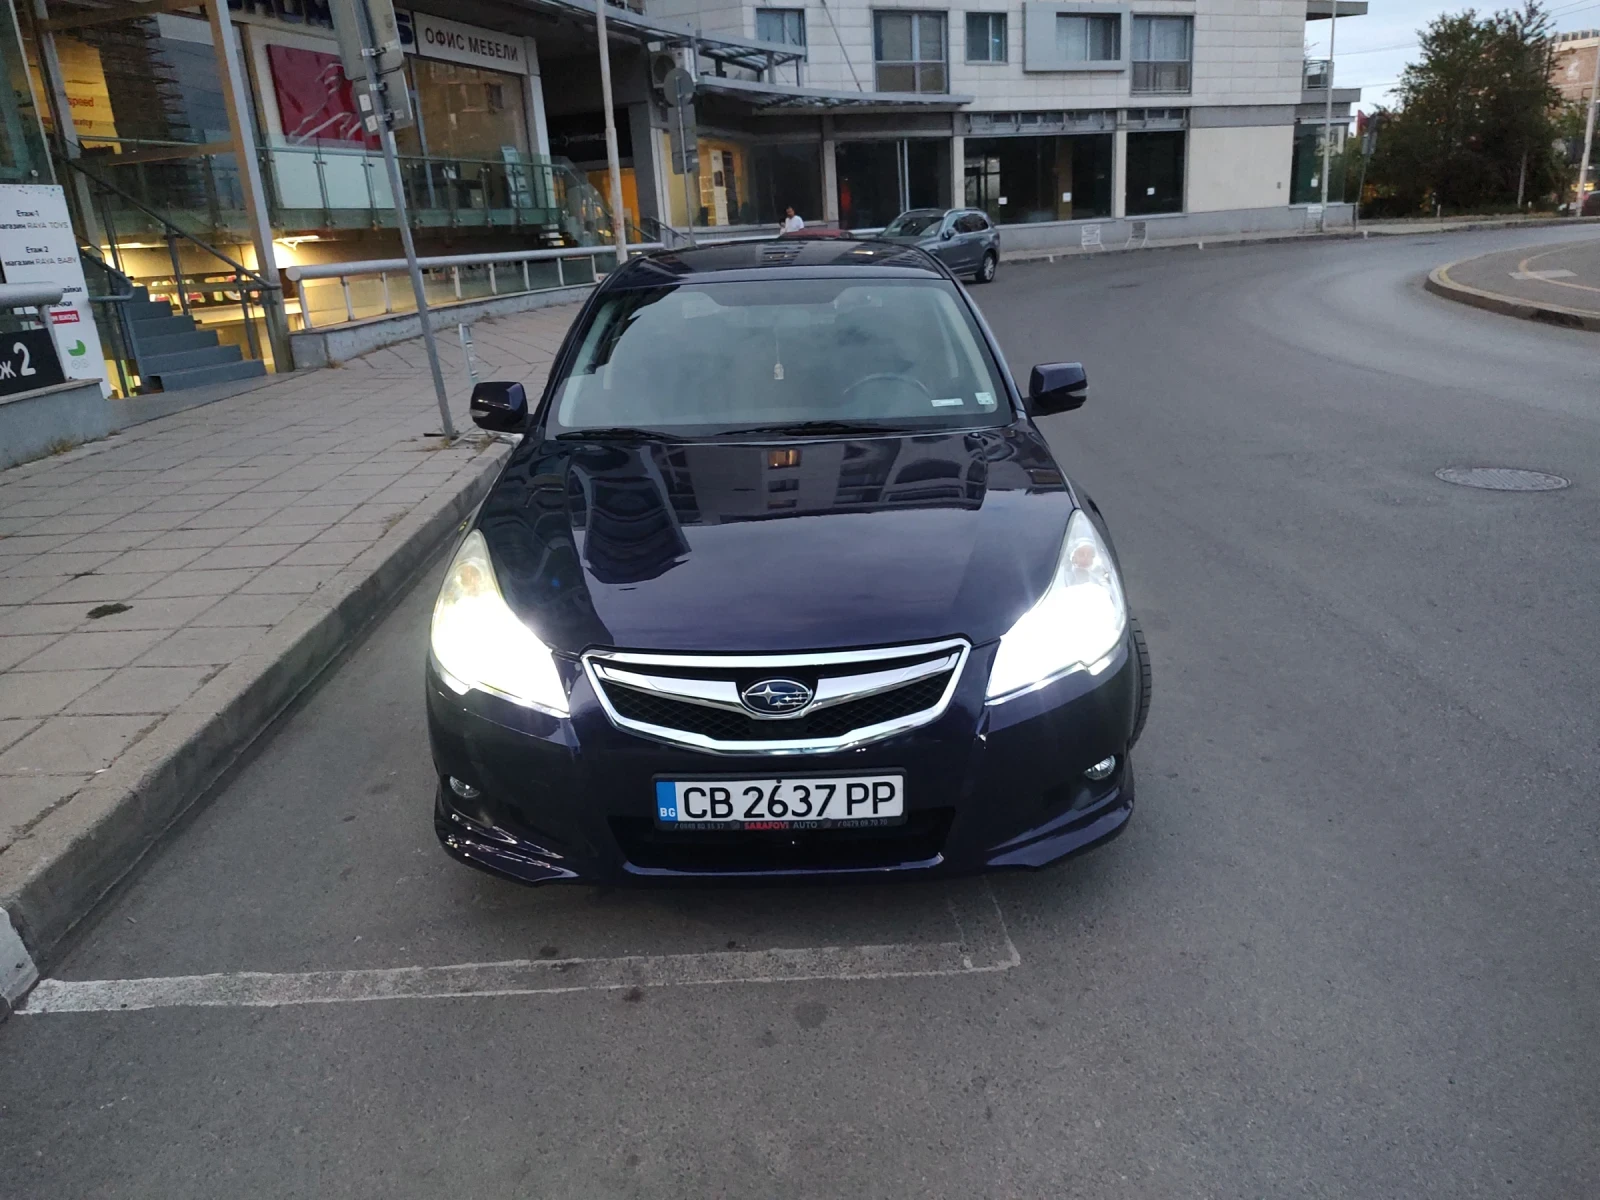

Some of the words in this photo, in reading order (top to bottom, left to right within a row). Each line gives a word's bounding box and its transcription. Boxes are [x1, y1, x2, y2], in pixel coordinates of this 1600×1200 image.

[425, 27, 465, 51] ОФИС
[468, 36, 518, 61] МЕБЕЛИ
[16, 209, 34, 217] Етаж
[48, 221, 69, 229] TOYS
[25, 246, 43, 254] Етаж
[44, 245, 49, 253] 2
[13, 342, 36, 376] 2
[683, 787, 734, 818] CB
[742, 783, 836, 818] 2637
[846, 781, 896, 816] PP
[660, 807, 676, 817] BG
[744, 821, 789, 830] SARAFOVI
[793, 821, 818, 829] AUTO
